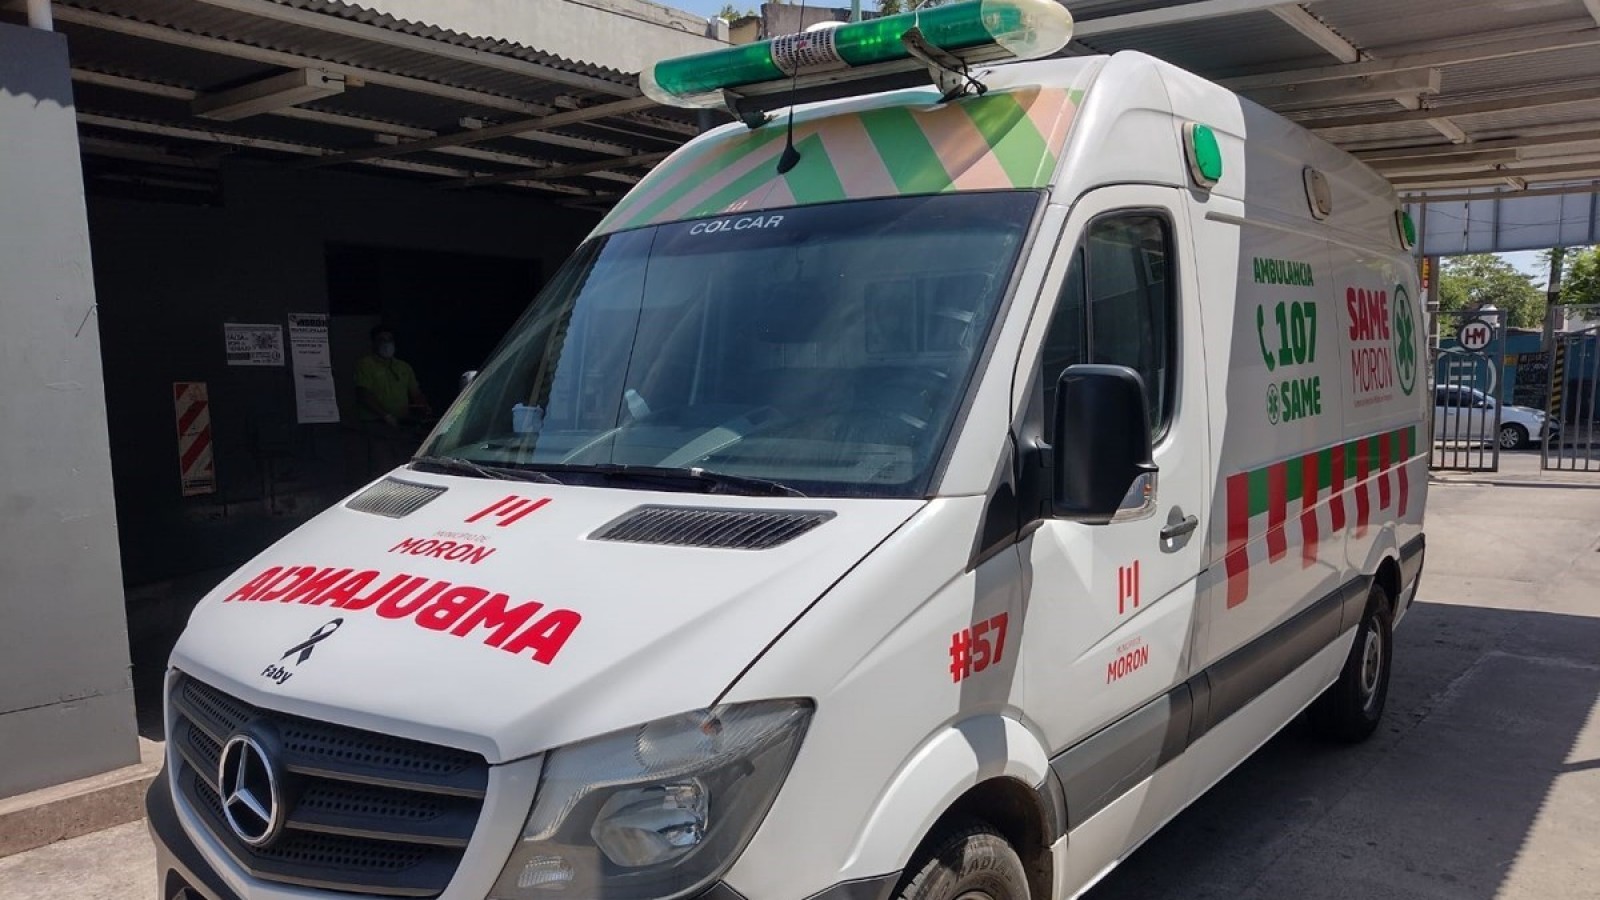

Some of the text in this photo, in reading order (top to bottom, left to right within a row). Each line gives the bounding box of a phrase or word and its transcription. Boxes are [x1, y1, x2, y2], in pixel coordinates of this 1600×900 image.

[689, 215, 784, 236] COLCAR
[1253, 257, 1314, 287] AMBULANCIA
[1276, 301, 1316, 366] 107
[1346, 287, 1389, 341] SAME
[1465, 327, 1486, 345] HM
[1351, 347, 1392, 394] MORON
[1281, 376, 1321, 422] SAME
[388, 537, 496, 565] MORON
[948, 611, 1009, 684] #57
[1106, 644, 1149, 685] MORON
[260, 663, 293, 686] Faby
